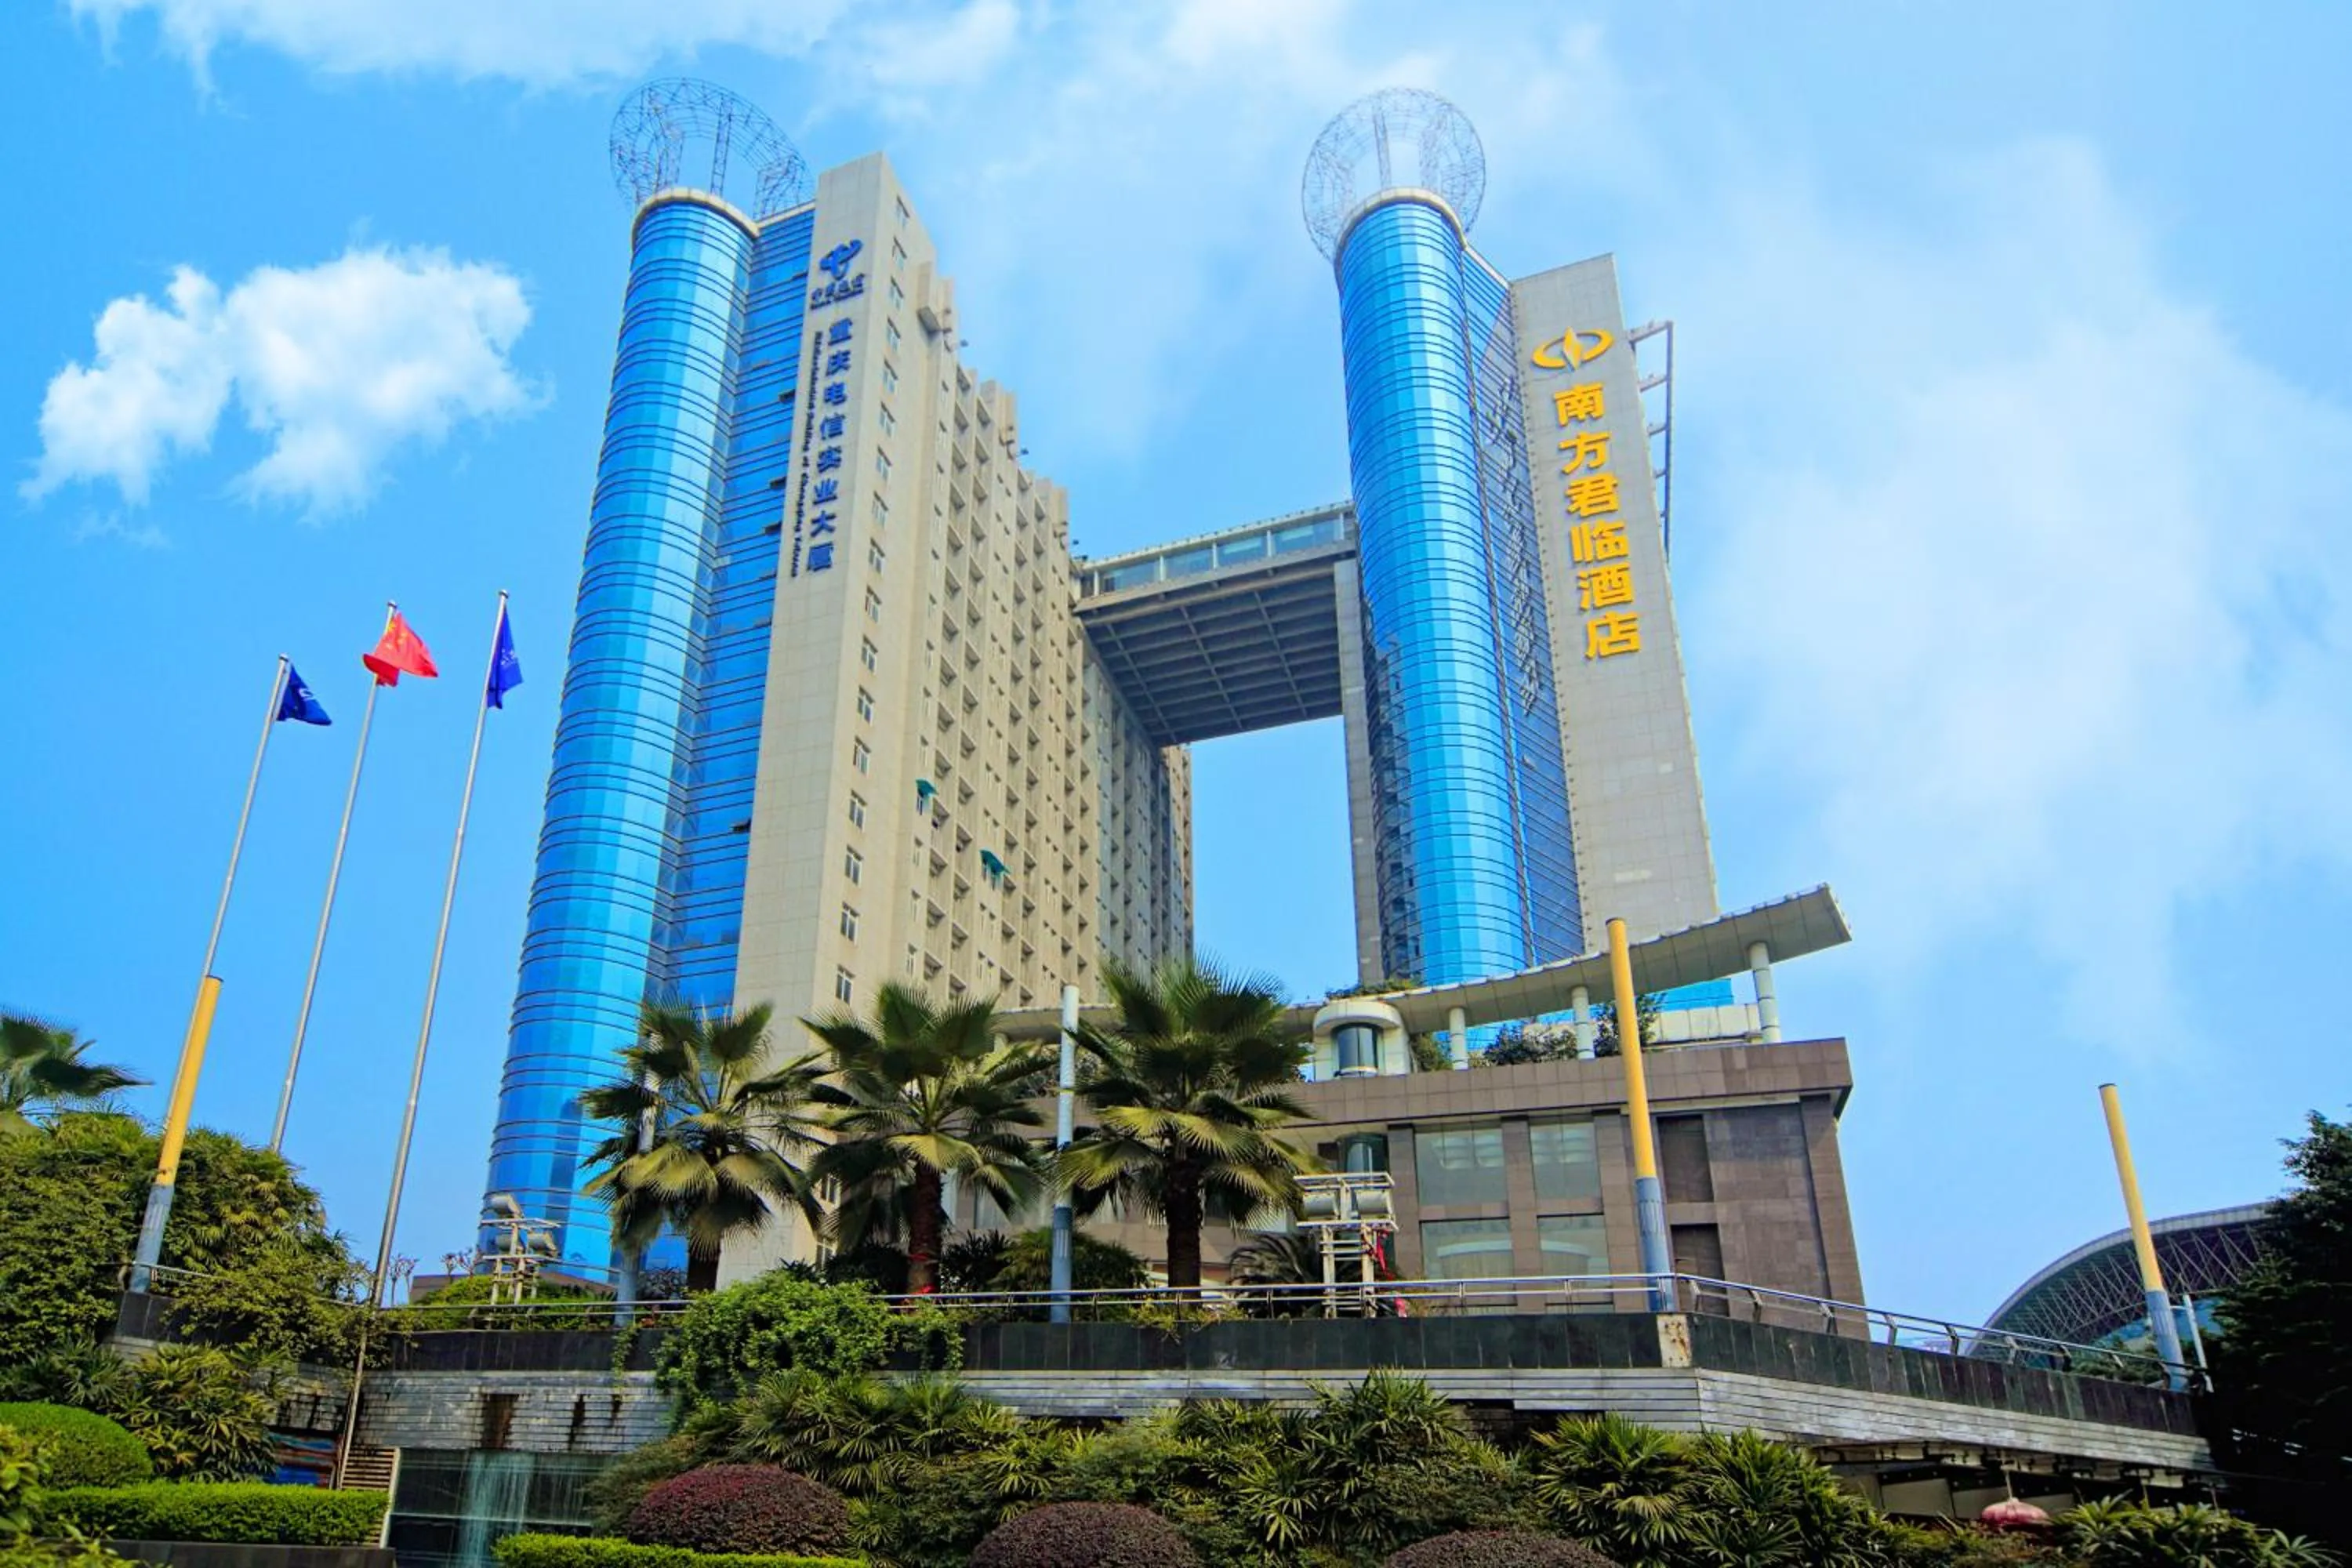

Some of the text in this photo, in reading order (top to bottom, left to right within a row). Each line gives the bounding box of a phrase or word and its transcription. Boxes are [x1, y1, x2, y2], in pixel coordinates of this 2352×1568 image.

[806, 317, 853, 572] 重庆电信实业大厦
[1554, 382, 1641, 661] 南方君临酒店
